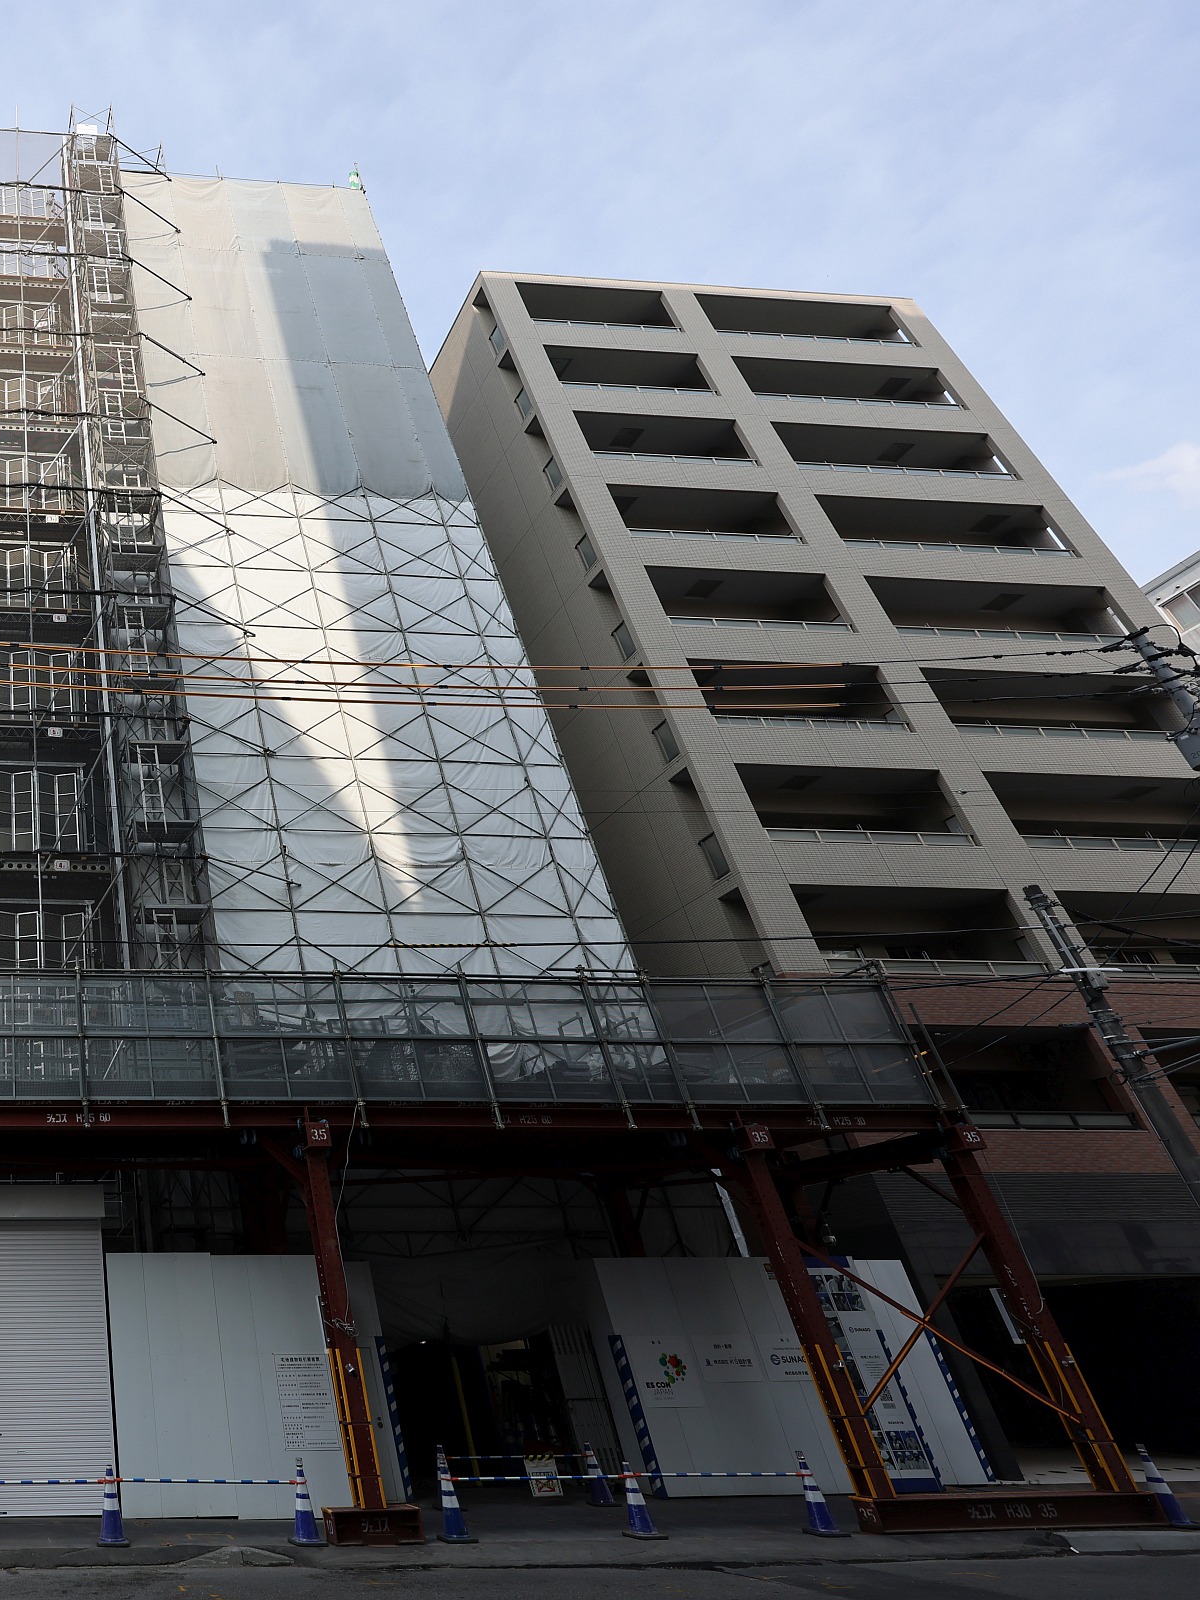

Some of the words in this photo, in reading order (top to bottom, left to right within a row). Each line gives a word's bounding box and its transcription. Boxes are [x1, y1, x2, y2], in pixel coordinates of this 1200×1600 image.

[781, 1355, 806, 1363] SUNAG
[646, 1381, 655, 1389] ES
[1003, 1503, 1032, 1518] H30
